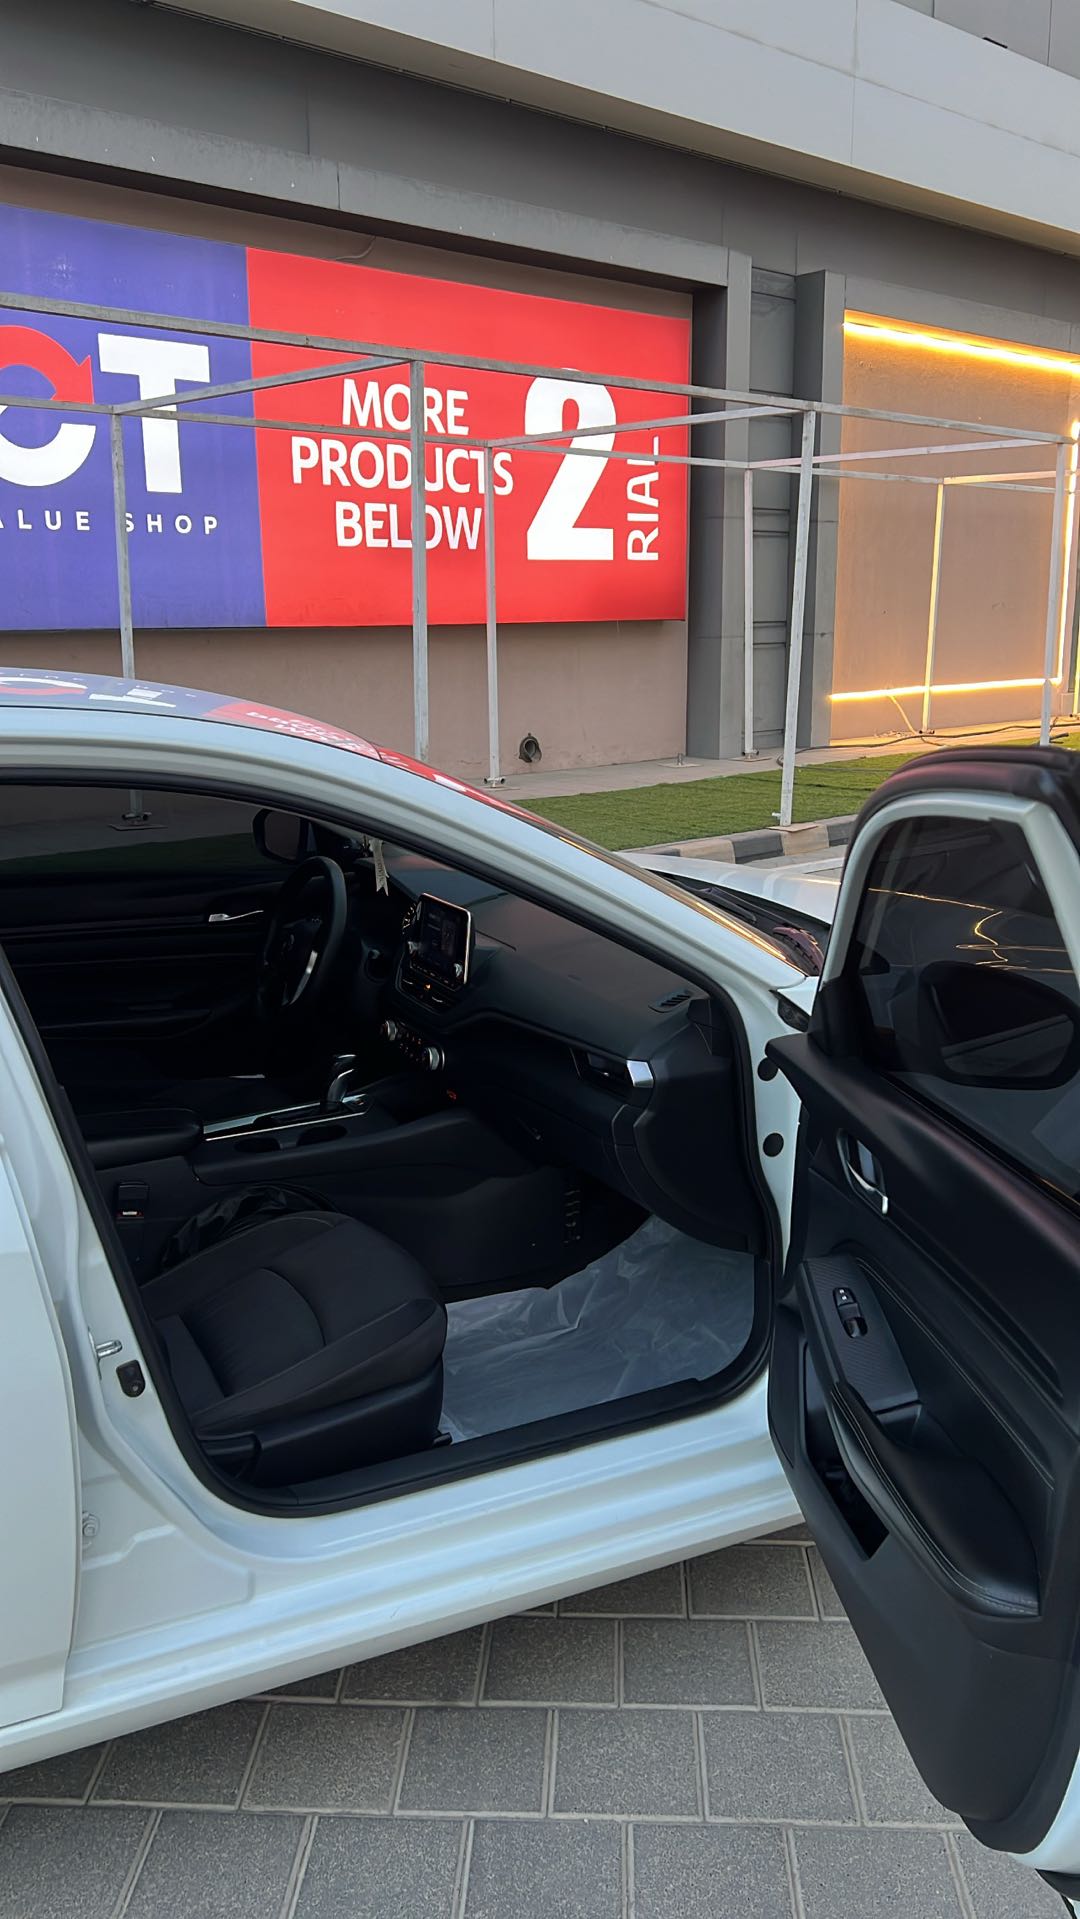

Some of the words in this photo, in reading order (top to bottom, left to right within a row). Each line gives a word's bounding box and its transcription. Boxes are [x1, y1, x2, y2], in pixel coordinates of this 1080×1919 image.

[342, 378, 469, 435] MORE
[291, 435, 514, 495] PRODUCTS
[524, 367, 616, 560] 2
[626, 435, 659, 560] RIAL
[0, 509, 90, 531] LUE
[125, 512, 218, 535] SHOP
[335, 500, 482, 550] BELOW
